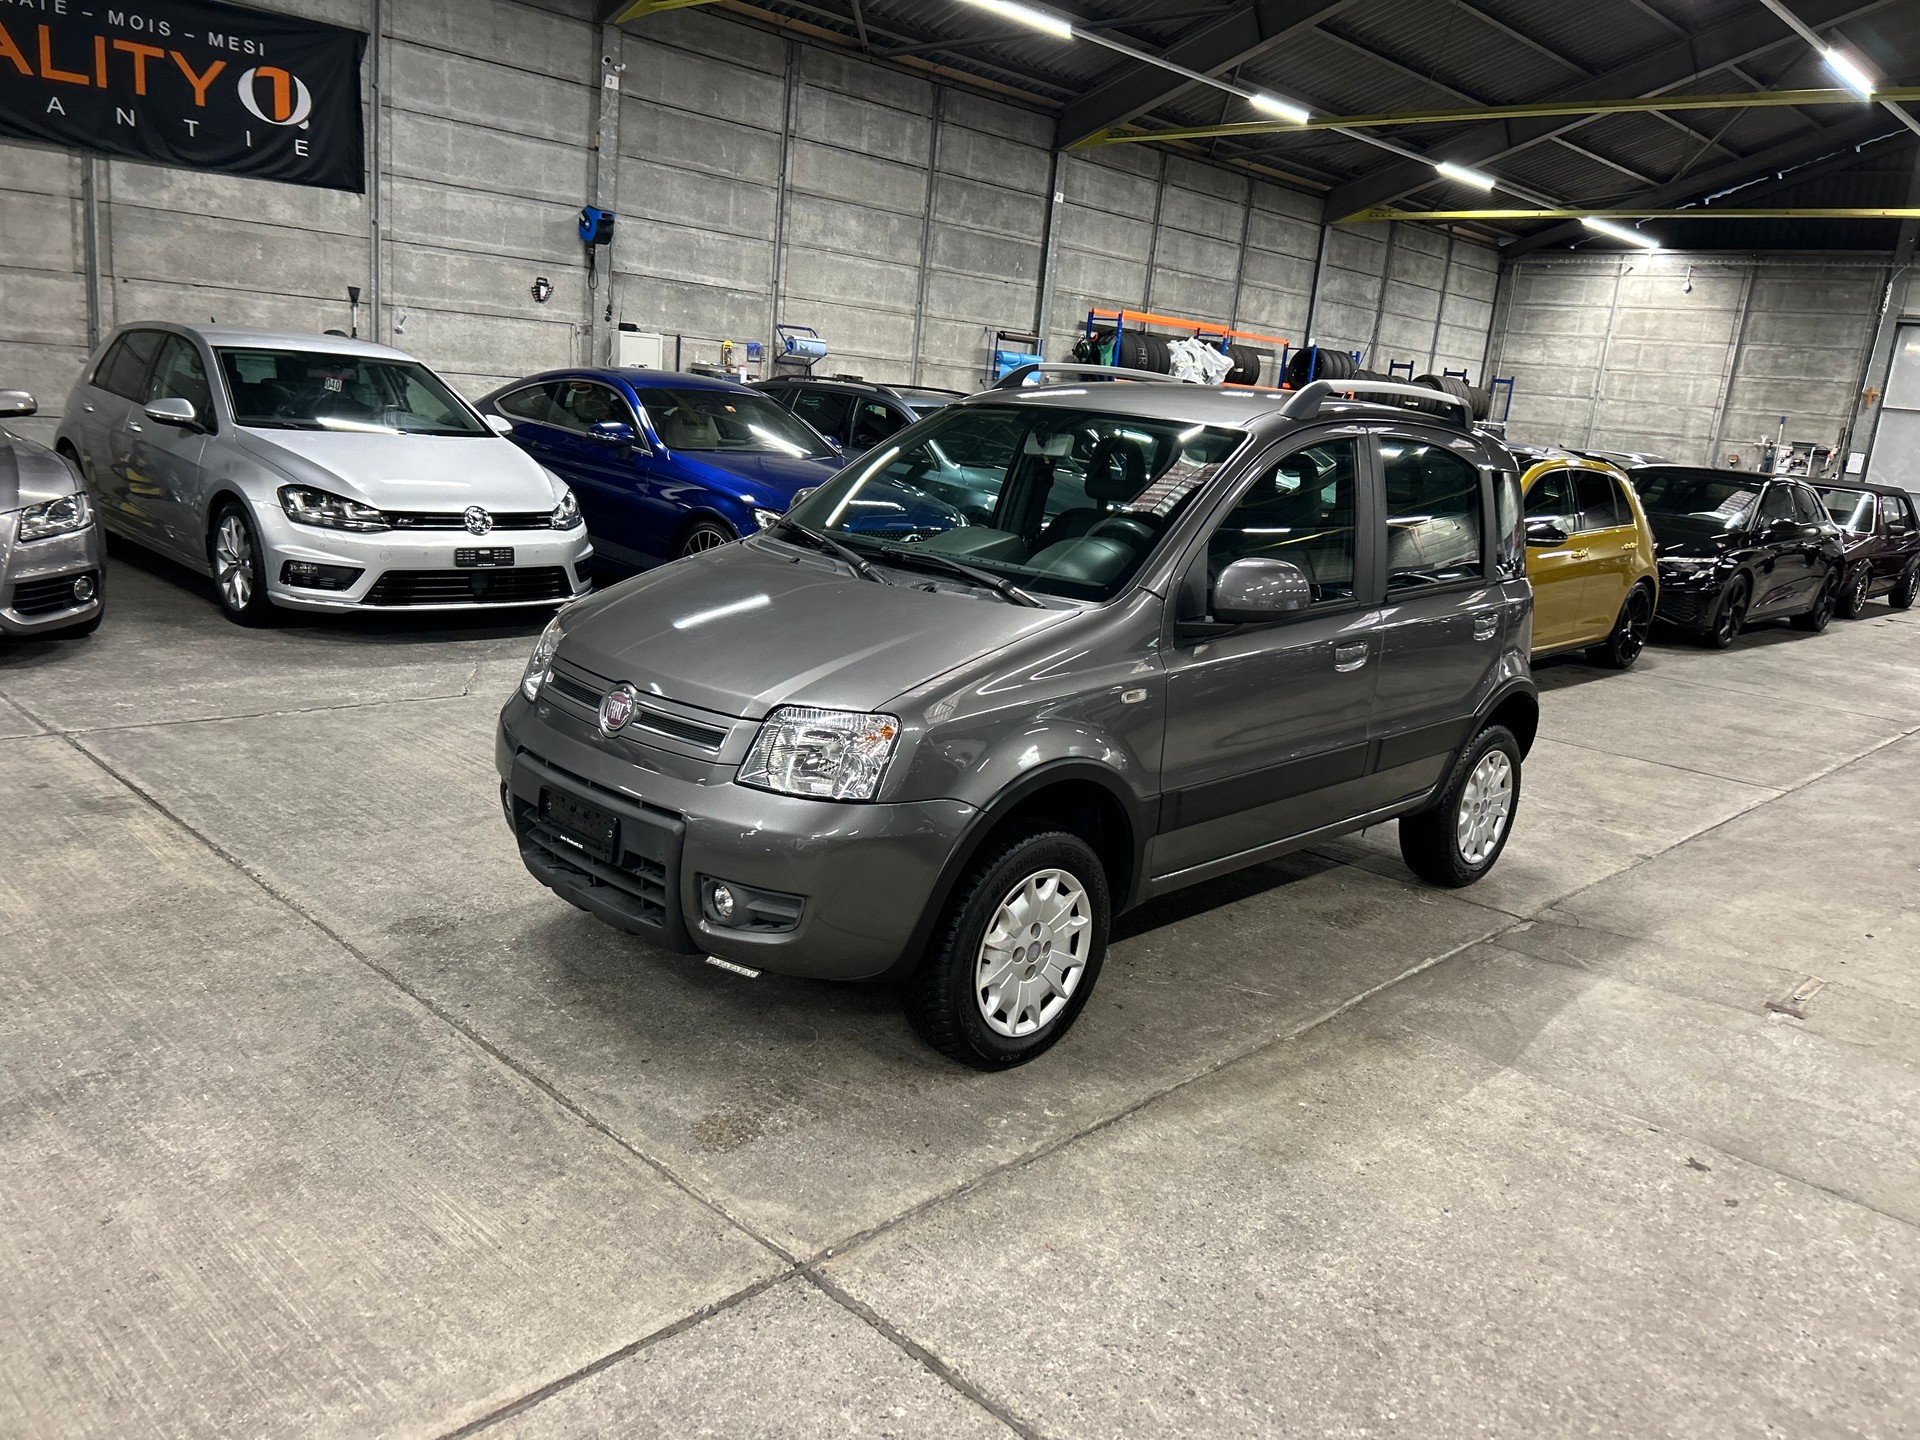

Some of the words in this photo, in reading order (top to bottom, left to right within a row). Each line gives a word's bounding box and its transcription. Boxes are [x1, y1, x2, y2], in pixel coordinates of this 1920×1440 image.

[108, 10, 171, 36] MOIS
[208, 32, 265, 56] MESI
[1137, 347, 1148, 365] HR
[607, 699, 626, 721] FIAT
